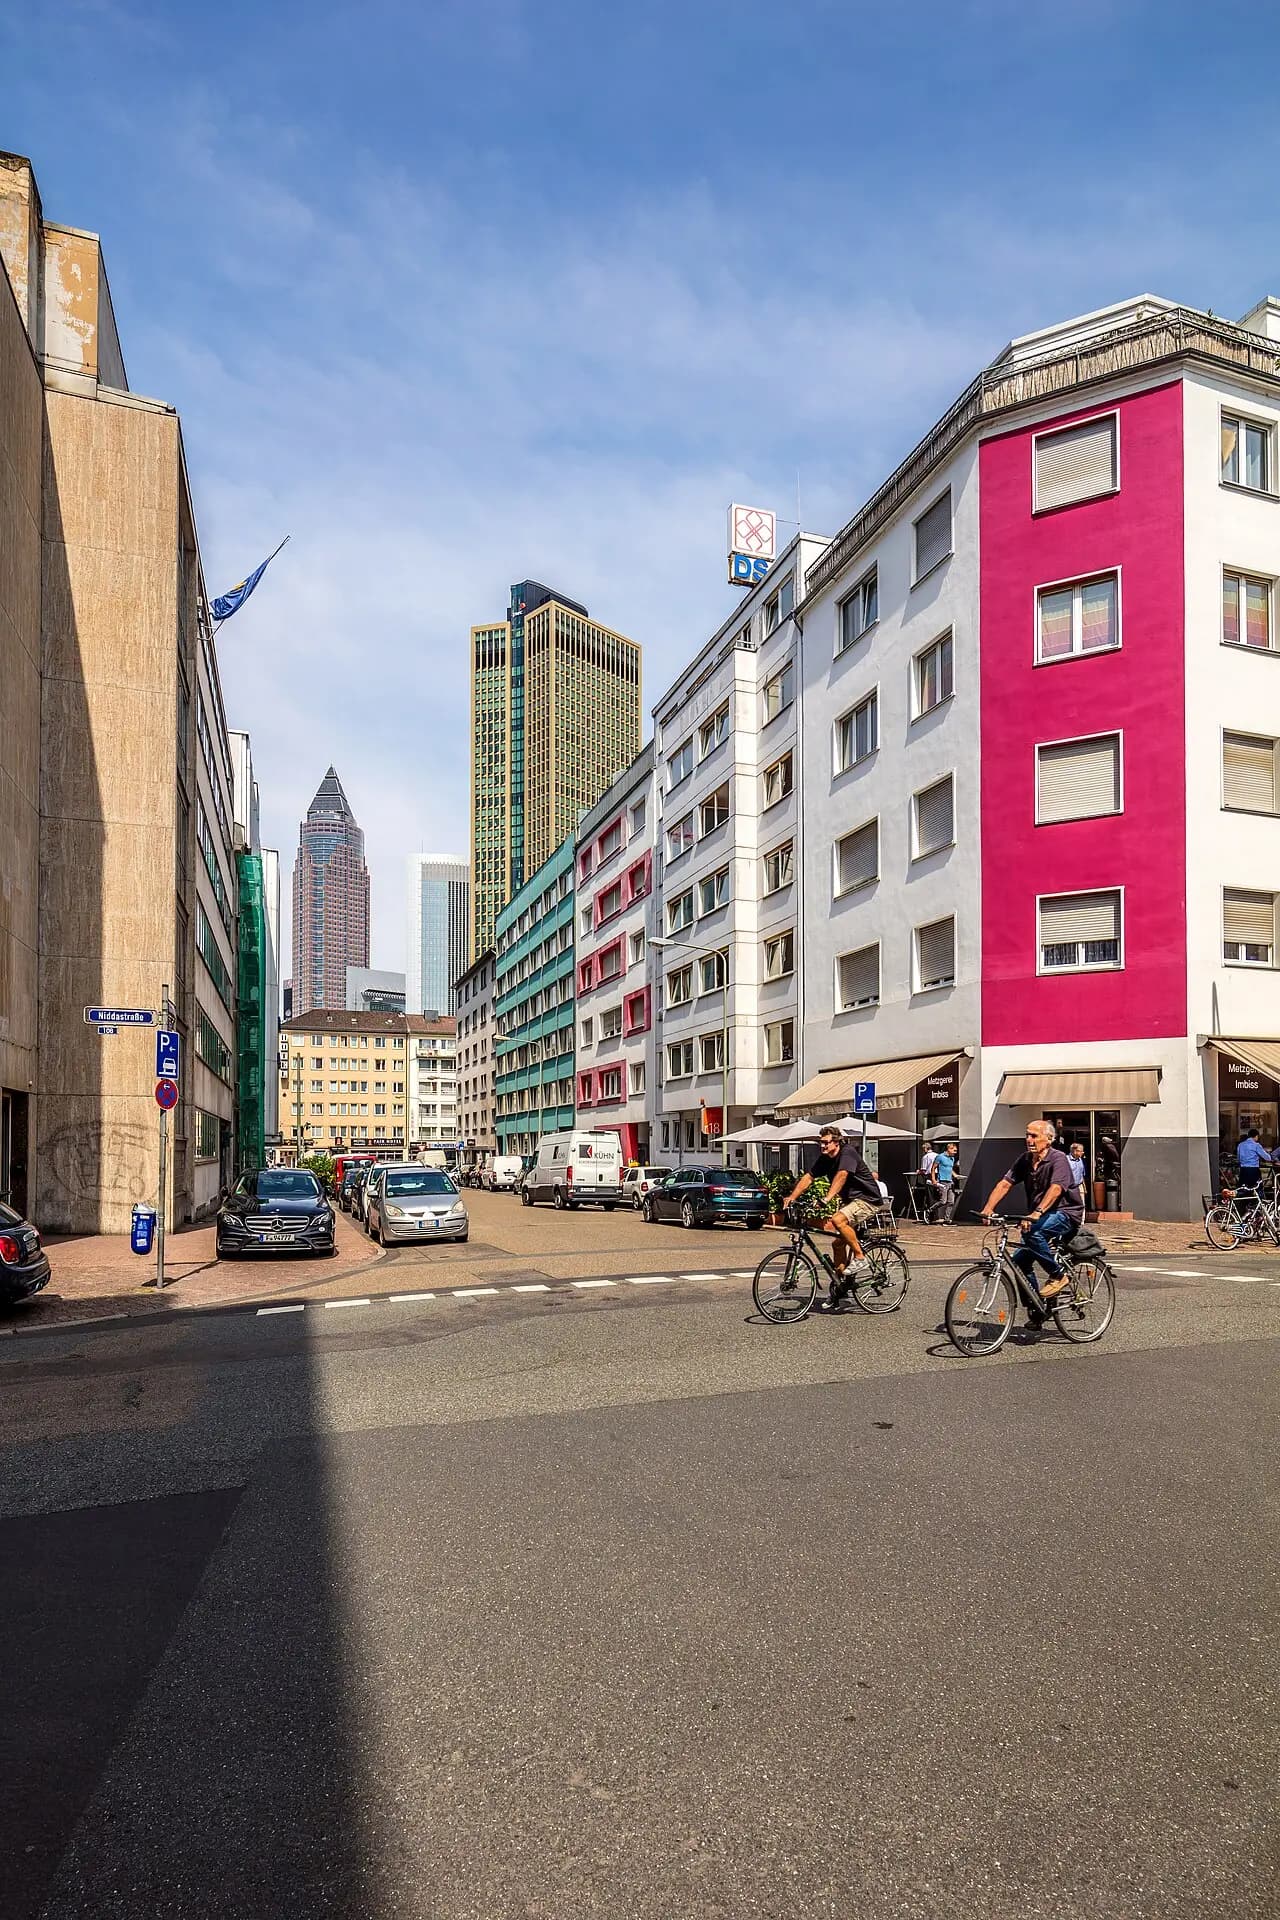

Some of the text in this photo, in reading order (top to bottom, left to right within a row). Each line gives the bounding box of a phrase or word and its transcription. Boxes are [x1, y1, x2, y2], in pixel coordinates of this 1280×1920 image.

[98, 1011, 144, 1022] Niddastraße
[160, 1034, 170, 1052] P
[1228, 1063, 1261, 1075] Metzger
[927, 1074, 953, 1086] Metzgerei
[1235, 1079, 1259, 1089] Imbiss
[858, 1085, 868, 1097] P
[931, 1090, 949, 1099] Imbiss
[594, 1151, 615, 1160] KÜHN
